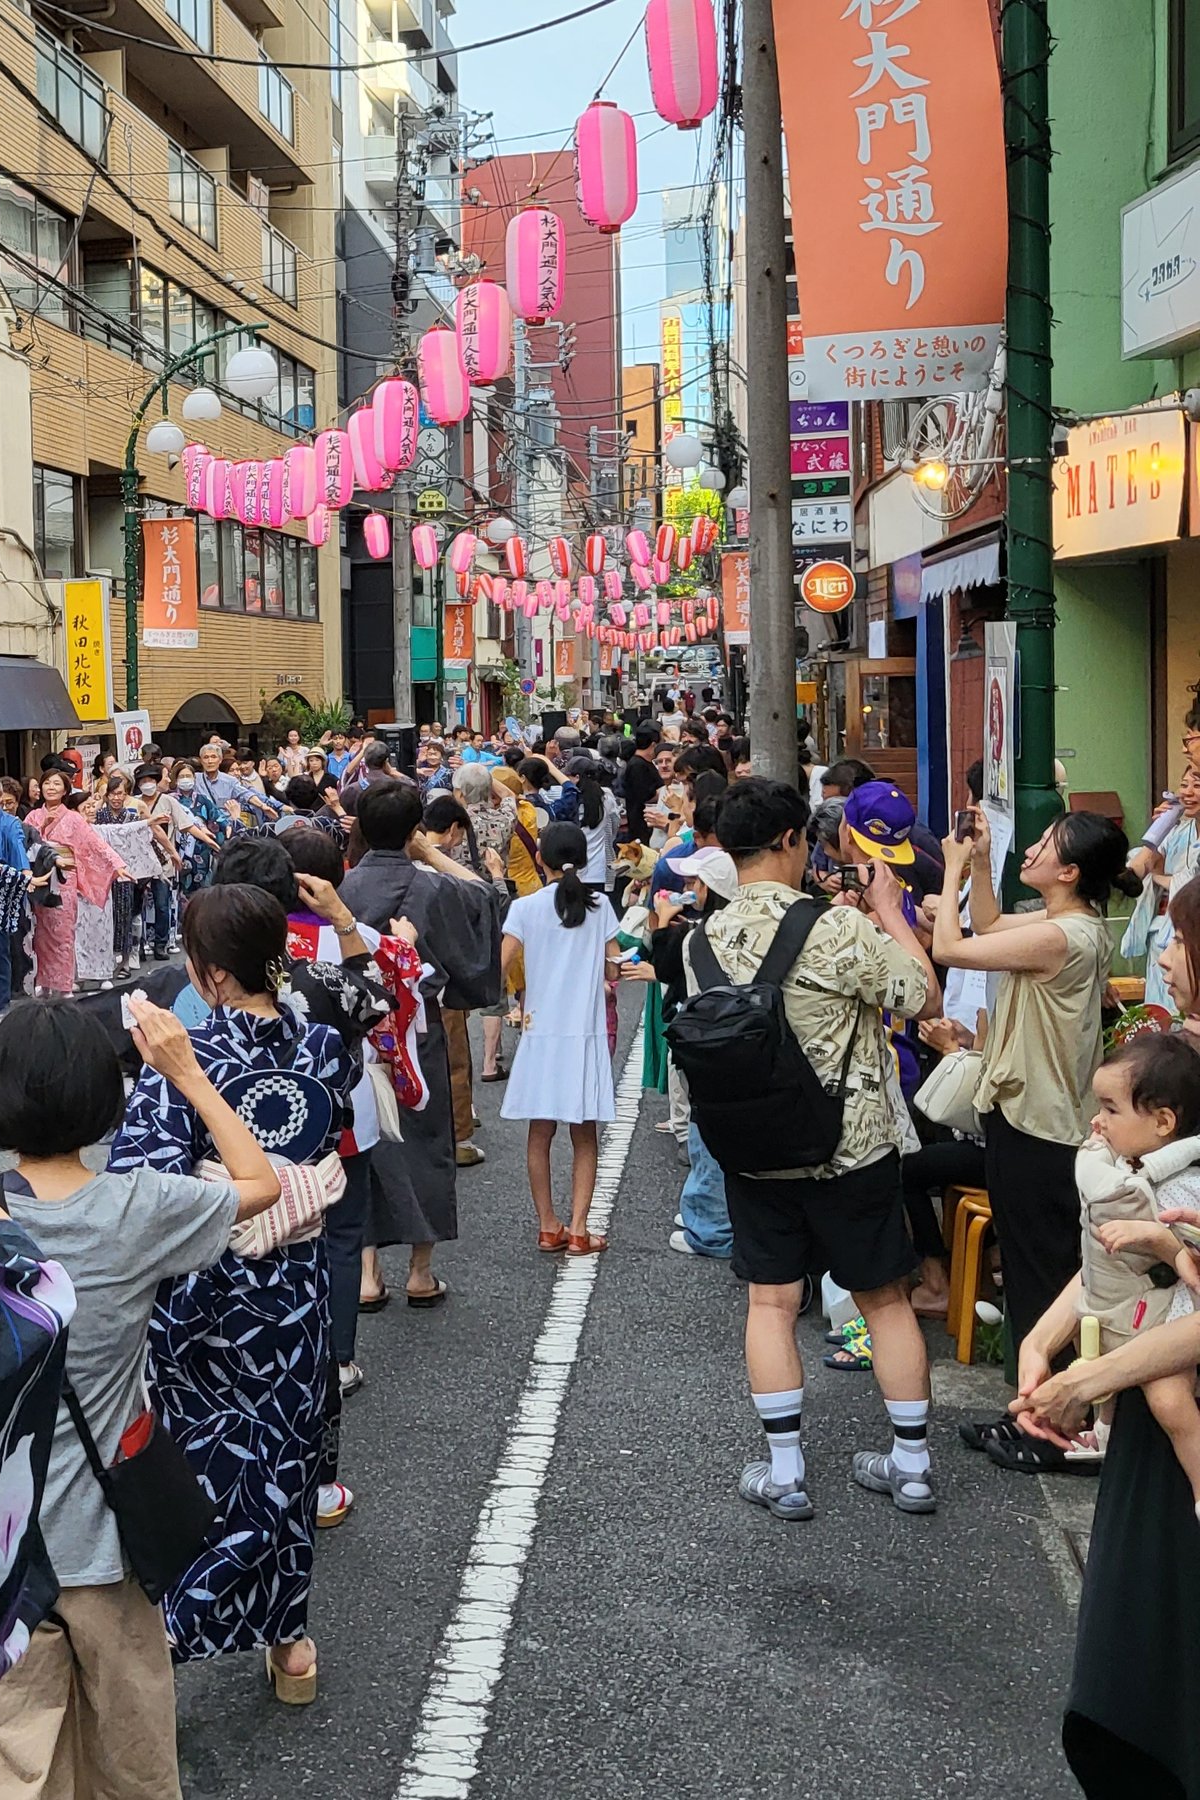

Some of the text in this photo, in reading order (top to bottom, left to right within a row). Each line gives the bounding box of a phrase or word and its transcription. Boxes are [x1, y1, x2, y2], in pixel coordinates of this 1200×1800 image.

[537, 214, 559, 313] 杉大門通り人気会
[462, 286, 484, 377] 杉大門通り人気会
[825, 334, 986, 364] くつろぎと憩いの
[844, 361, 966, 388] 街にようこそ
[398, 385, 415, 466] 杉大門通り人気会
[790, 441, 827, 452] すなっく
[806, 451, 847, 471] 武藤
[803, 481, 837, 494] 2F
[1067, 441, 1161, 519] MATES
[792, 518, 848, 536] なにわ
[800, 506, 839, 516] 居酒屋
[160, 526, 182, 625] 杉大門通り
[453, 607, 465, 657] 杉大門通り
[72, 614, 92, 705] 秋田北秋田
